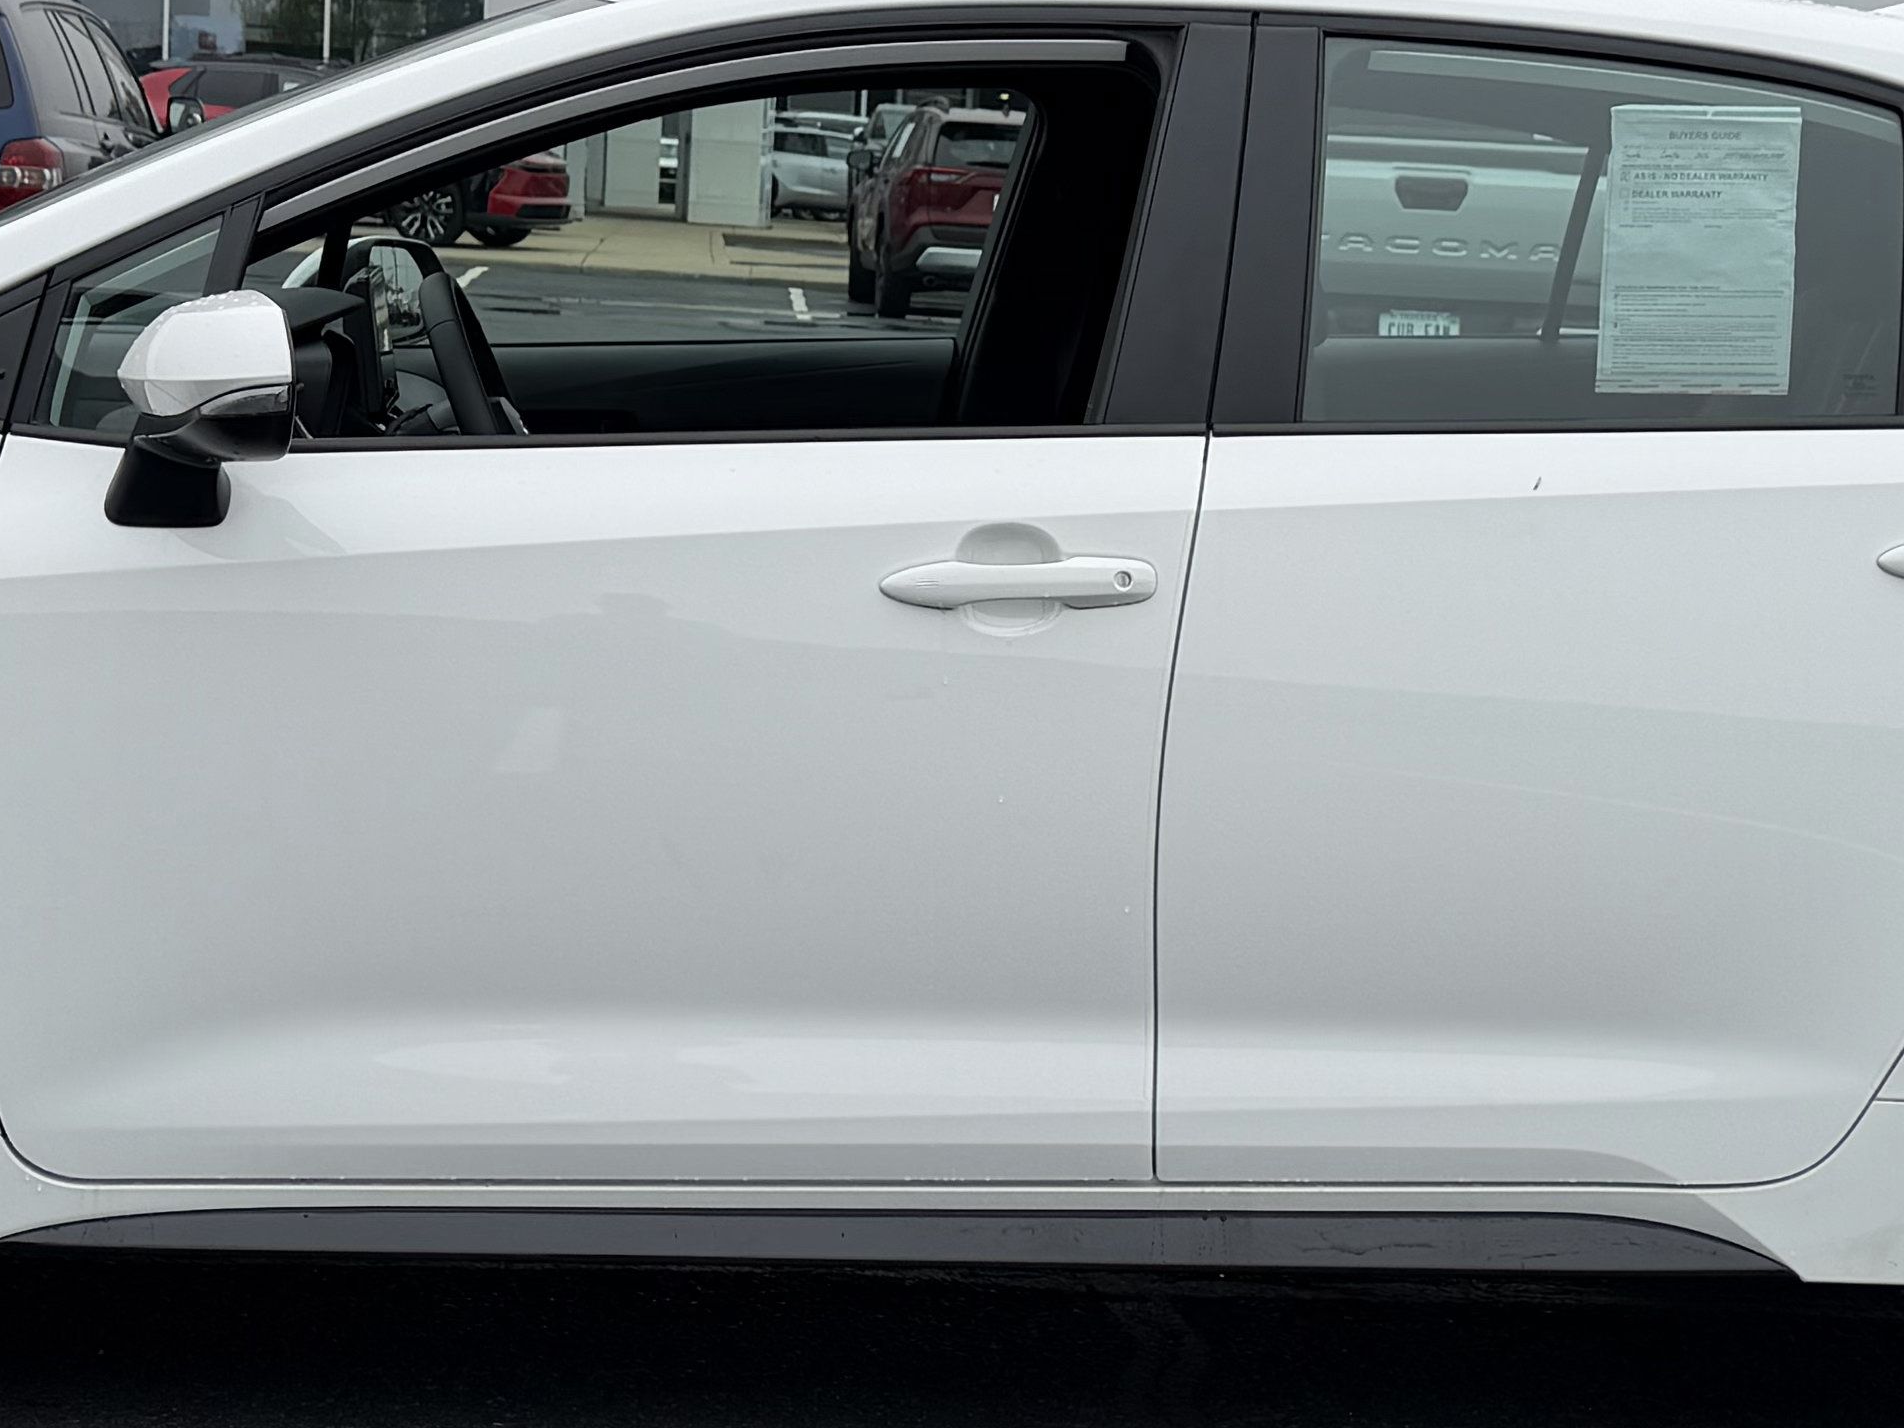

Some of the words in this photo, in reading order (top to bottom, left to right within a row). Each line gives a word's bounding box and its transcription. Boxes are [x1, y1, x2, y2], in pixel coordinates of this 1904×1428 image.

[1668, 131, 1709, 140] BUYERS
[1712, 132, 1742, 141] GUIDE
[1322, 232, 1560, 262] ACOMA
